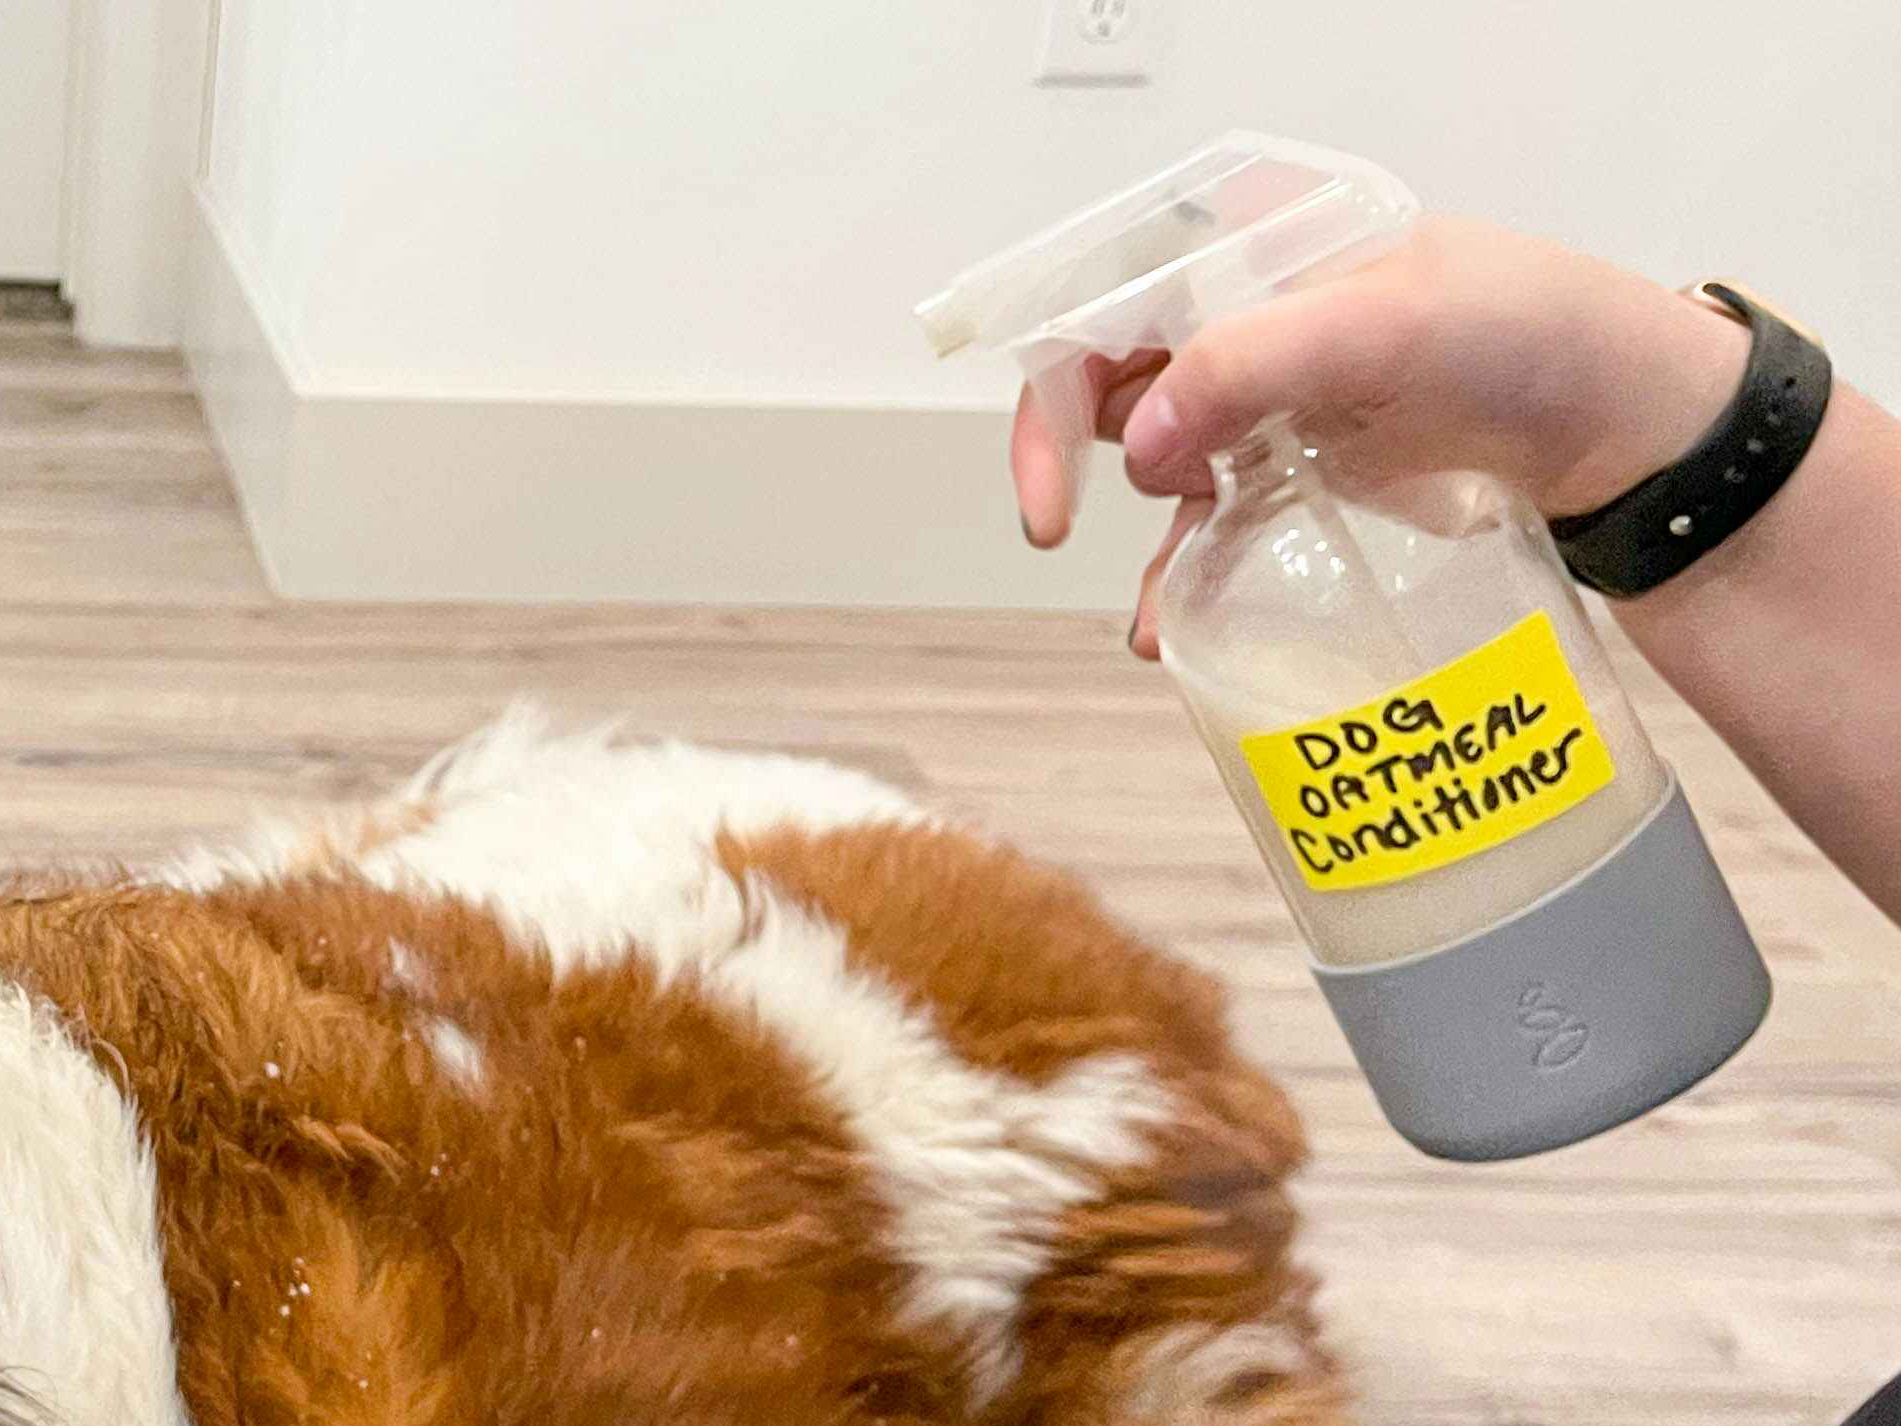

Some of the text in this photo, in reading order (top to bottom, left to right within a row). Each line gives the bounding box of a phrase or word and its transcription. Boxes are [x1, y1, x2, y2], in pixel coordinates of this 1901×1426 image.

[1293, 697, 1444, 771] DOG
[1300, 693, 1546, 820] OATMEAL
[1289, 727, 1582, 874] Conditioner
